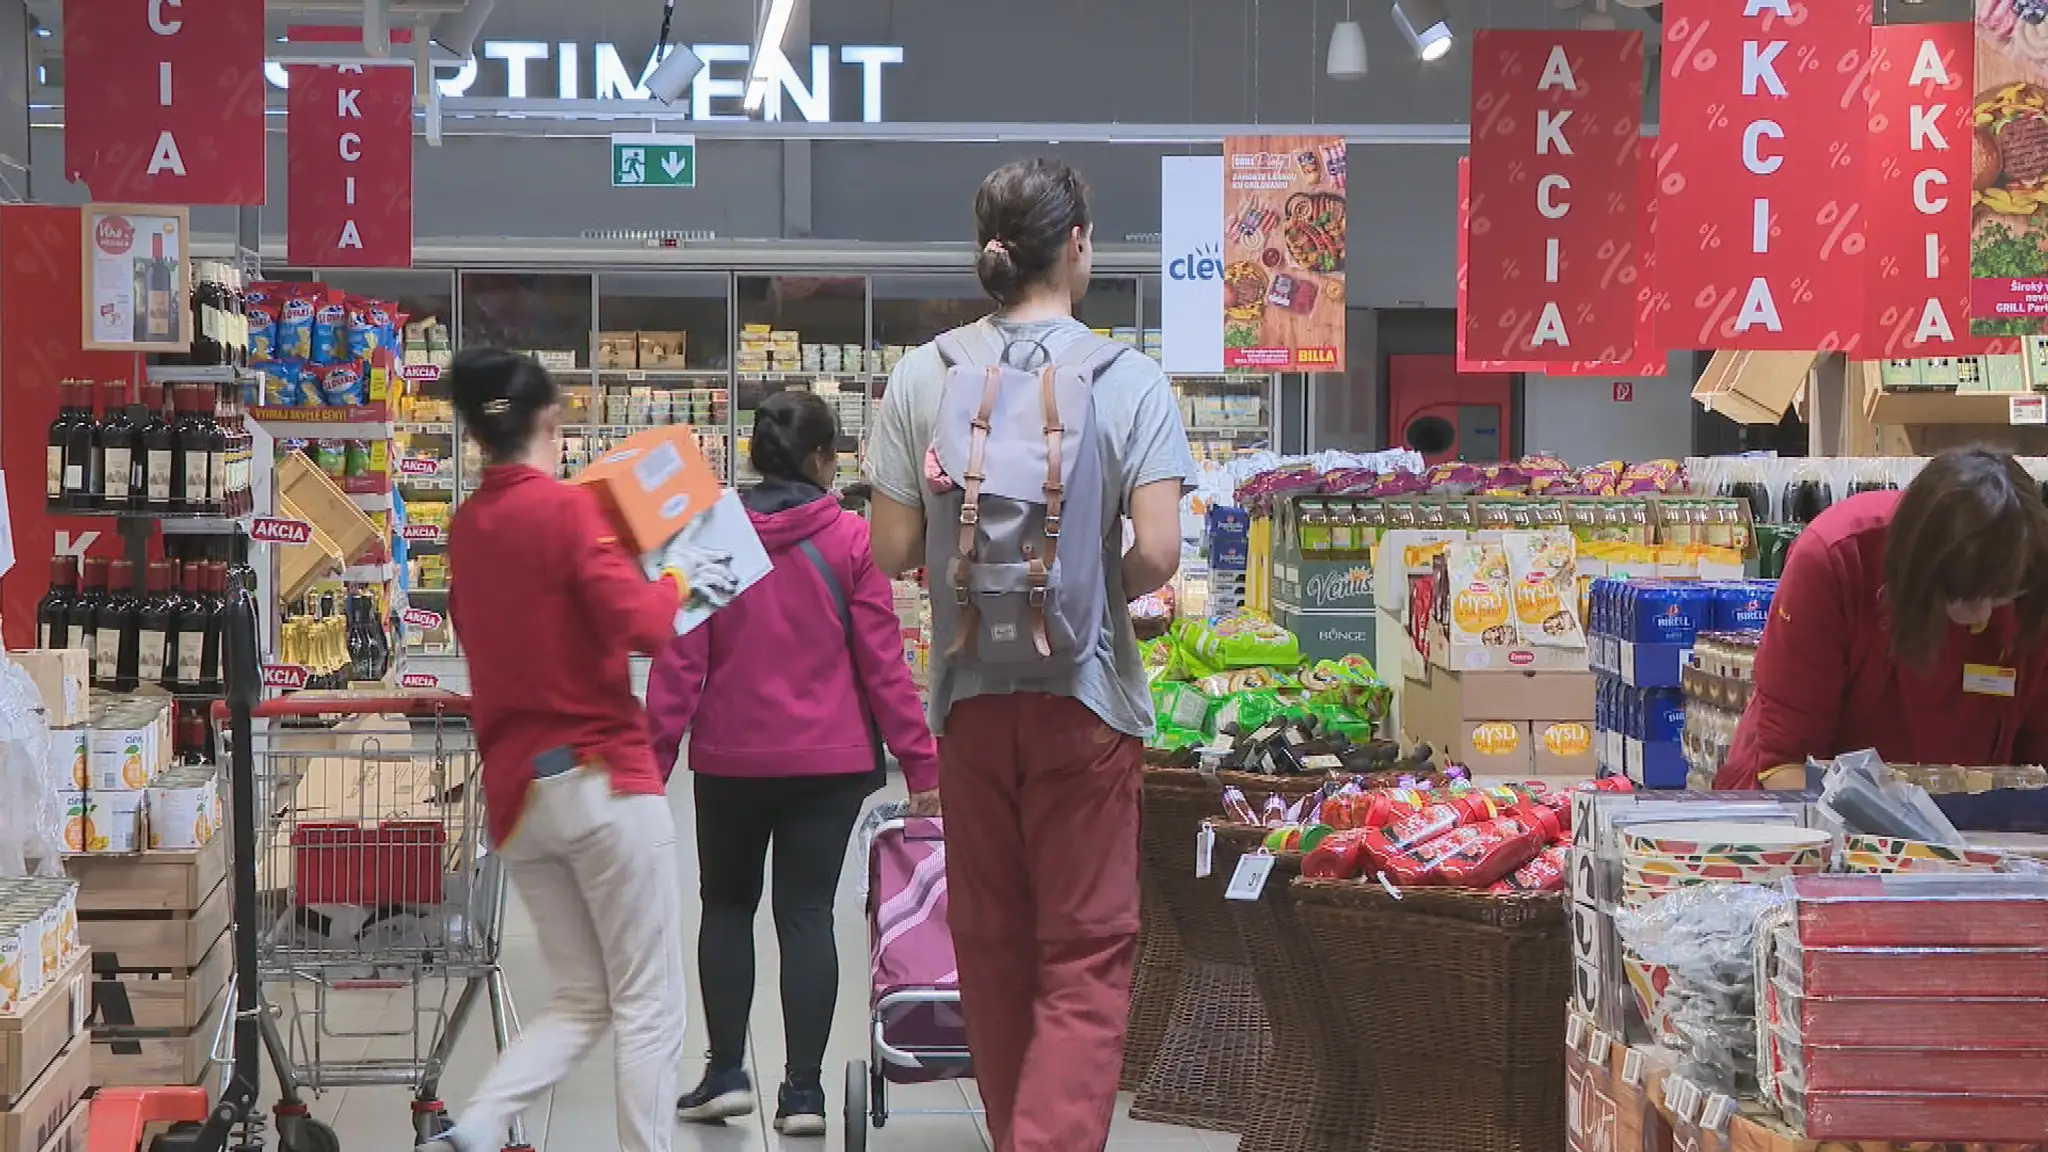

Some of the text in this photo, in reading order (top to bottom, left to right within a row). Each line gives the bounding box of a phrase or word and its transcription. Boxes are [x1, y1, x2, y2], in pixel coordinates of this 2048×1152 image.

[1734, 0, 1793, 332] KCIA
[1531, 45, 1577, 346] AKCIA
[1908, 39, 1955, 343] AKCIA
[1996, 303, 2026, 313] GRILL
[1299, 350, 1334, 362] BILLA
[405, 367, 436, 377] AKCIA
[402, 461, 434, 473] AKCIA
[255, 523, 305, 542] AKCIA
[404, 528, 435, 537] AKCIA
[404, 612, 437, 626] AKCIA
[1658, 615, 1691, 627] BIRELL
[264, 669, 301, 686] KCIA
[403, 676, 435, 687] AKCIA
